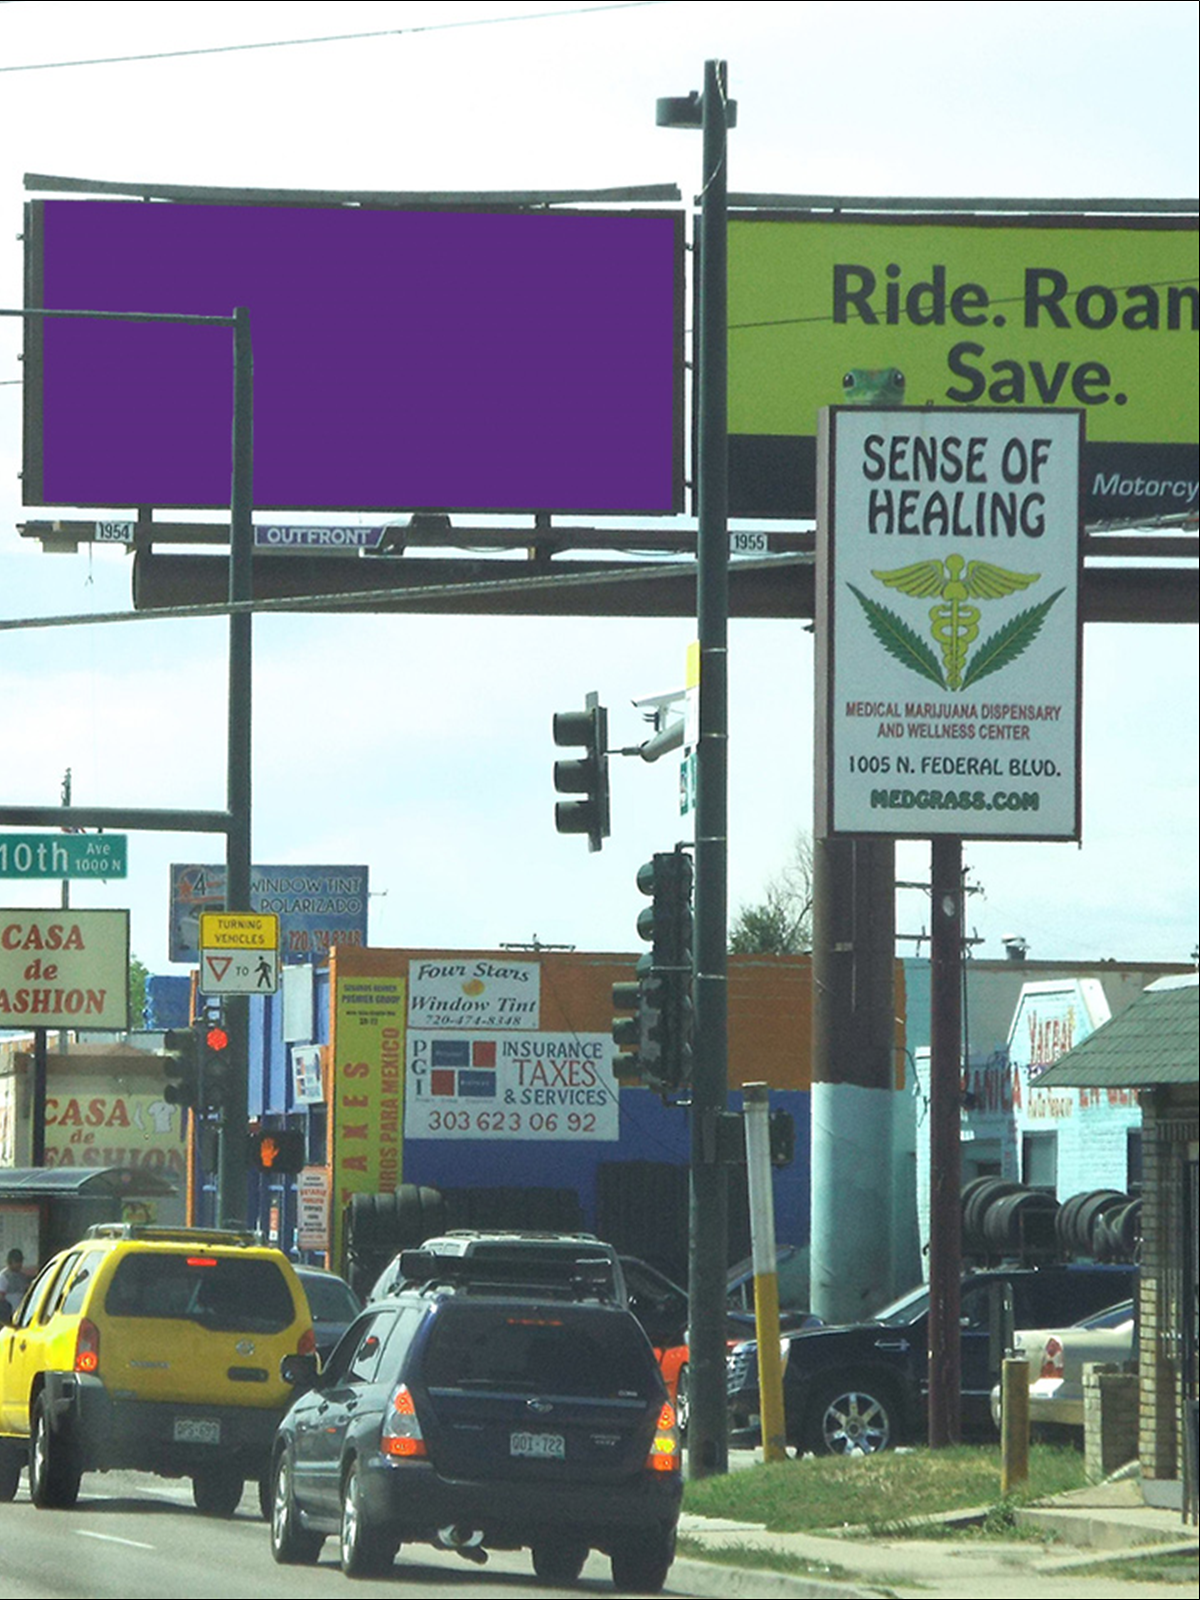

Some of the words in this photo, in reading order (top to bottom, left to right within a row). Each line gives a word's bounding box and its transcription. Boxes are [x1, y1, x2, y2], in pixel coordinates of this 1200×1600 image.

[833, 263, 1007, 327] Ride.
[945, 341, 1128, 406] Save.
[863, 434, 988, 484] SENSE
[1001, 437, 1053, 484] OF
[868, 489, 1046, 538] HEALING
[100, 522, 130, 539] 1954
[267, 528, 370, 544] OUTFRONT
[734, 534, 765, 551] 1955
[846, 702, 901, 718] MEDICAL
[905, 703, 978, 719] MARIJUANA
[981, 704, 1062, 721] DISPENSARY
[877, 723, 904, 738] AND
[907, 723, 976, 740] WELLNESS
[979, 724, 1030, 740] CENTER
[850, 756, 891, 773] 1005
[896, 756, 915, 774] N.
[921, 757, 1003, 775] FEDERAL
[1009, 759, 1061, 777] BLVD.
[870, 789, 1040, 811] MEDGRASS.COM
[86, 843, 111, 855] Ave
[75, 859, 108, 871] 1000
[112, 860, 121, 871] N
[327, 877, 363, 893] TINT
[260, 899, 362, 914] POLARIZADO
[217, 920, 263, 930] TURNING
[1, 923, 86, 950] CASA
[214, 934, 265, 945] VEHICLES
[23, 958, 58, 981] de
[236, 966, 249, 976] TO
[418, 964, 467, 981] Four
[473, 962, 530, 983] Stars
[411, 996, 490, 1012] Window
[498, 997, 536, 1013] Tint
[502, 1041, 603, 1059] INSURANCE
[381, 1027, 400, 1094] MEXICO
[512, 1059, 597, 1087] TAXES
[503, 1089, 517, 1105] &
[522, 1089, 607, 1106] SERVICES
[379, 1097, 399, 1143] PARA
[428, 1111, 470, 1131] 303
[476, 1112, 522, 1131] 623
[70, 1129, 95, 1144] de
